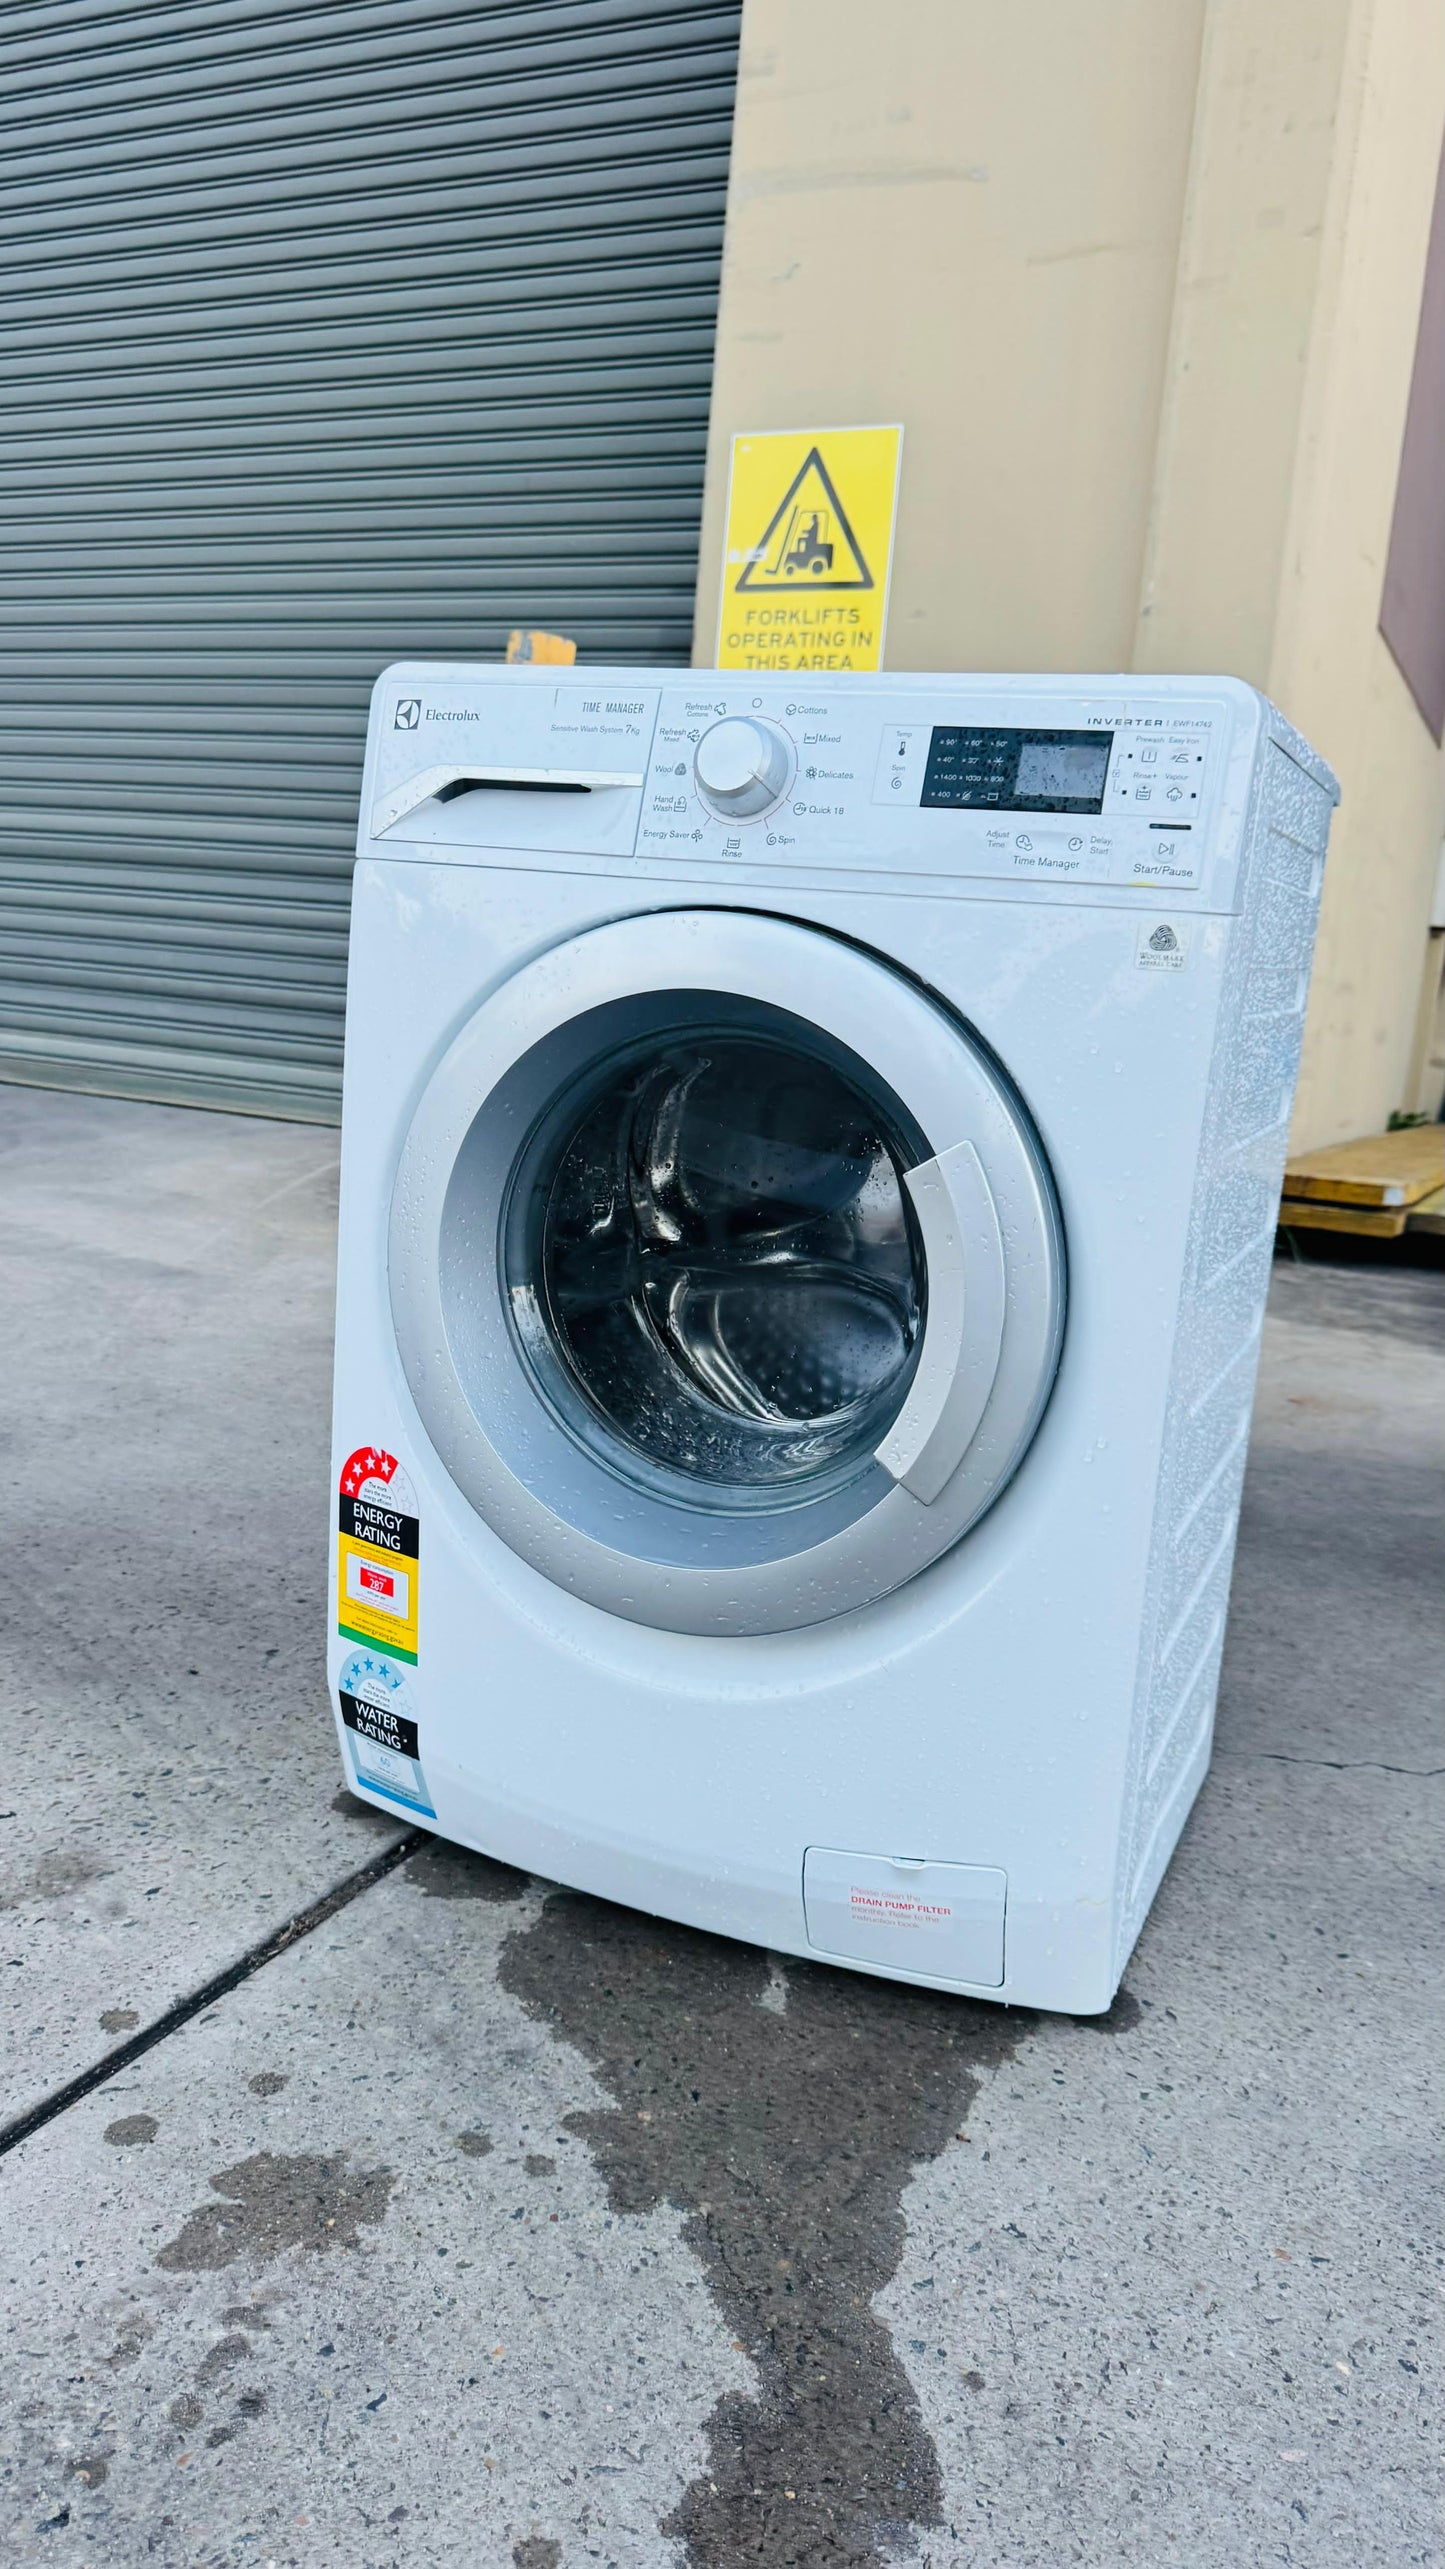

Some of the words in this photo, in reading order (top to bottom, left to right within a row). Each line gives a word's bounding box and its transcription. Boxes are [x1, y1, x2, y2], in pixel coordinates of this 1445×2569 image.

[745, 608, 861, 626] FORKLIFTS
[726, 631, 846, 649] OPERATING
[851, 631, 874, 648] IN
[745, 655, 791, 670] THIS
[796, 655, 855, 670] AREA
[582, 702, 602, 713] TIME
[605, 702, 645, 714] MANAGER
[685, 702, 713, 711] Refresh
[797, 705, 828, 715] Cottons
[425, 709, 481, 721] Electrolux
[1087, 717, 1163, 727] INVERTER
[550, 724, 579, 734] Sensitive
[580, 725, 599, 733] Wash
[599, 725, 624, 735] System
[659, 727, 687, 736] Refresh
[897, 730, 913, 738] Temp
[818, 734, 841, 743] Mixed
[1136, 735, 1165, 744] Prewash
[1168, 736, 1185, 745] Easy
[655, 764, 674, 773] Wool
[891, 763, 906, 772] Spin
[818, 770, 855, 780] Delicates
[940, 773, 957, 781] 1400
[937, 790, 951, 798] 400
[654, 795, 674, 804] Hand
[652, 804, 673, 812] Wash
[809, 805, 832, 815] Quick
[643, 829, 667, 839] Energy
[669, 830, 690, 839] Saver
[986, 829, 1010, 839] Adjust
[778, 835, 796, 846] Spin
[988, 840, 1006, 849] Time
[1090, 835, 1111, 846] Delay
[721, 849, 743, 858] Rinse
[1090, 846, 1109, 855] Start
[1013, 855, 1035, 866] Time
[1037, 857, 1080, 871] Manager
[1133, 863, 1194, 878] Start/Pause
[353, 1502, 403, 1532] ENERGY
[354, 1521, 401, 1550] RATING
[369, 1578, 385, 1593] 287
[355, 1700, 399, 1733] WATER
[356, 1717, 402, 1750] RATING
[850, 1886, 880, 1896] Please
[881, 1890, 905, 1900] clean
[906, 1893, 921, 1902] the
[851, 1896, 882, 1907] DRAIN
[884, 1900, 915, 1911] PUMP
[917, 1904, 951, 1916] FILTER
[914, 1913, 924, 1921] to
